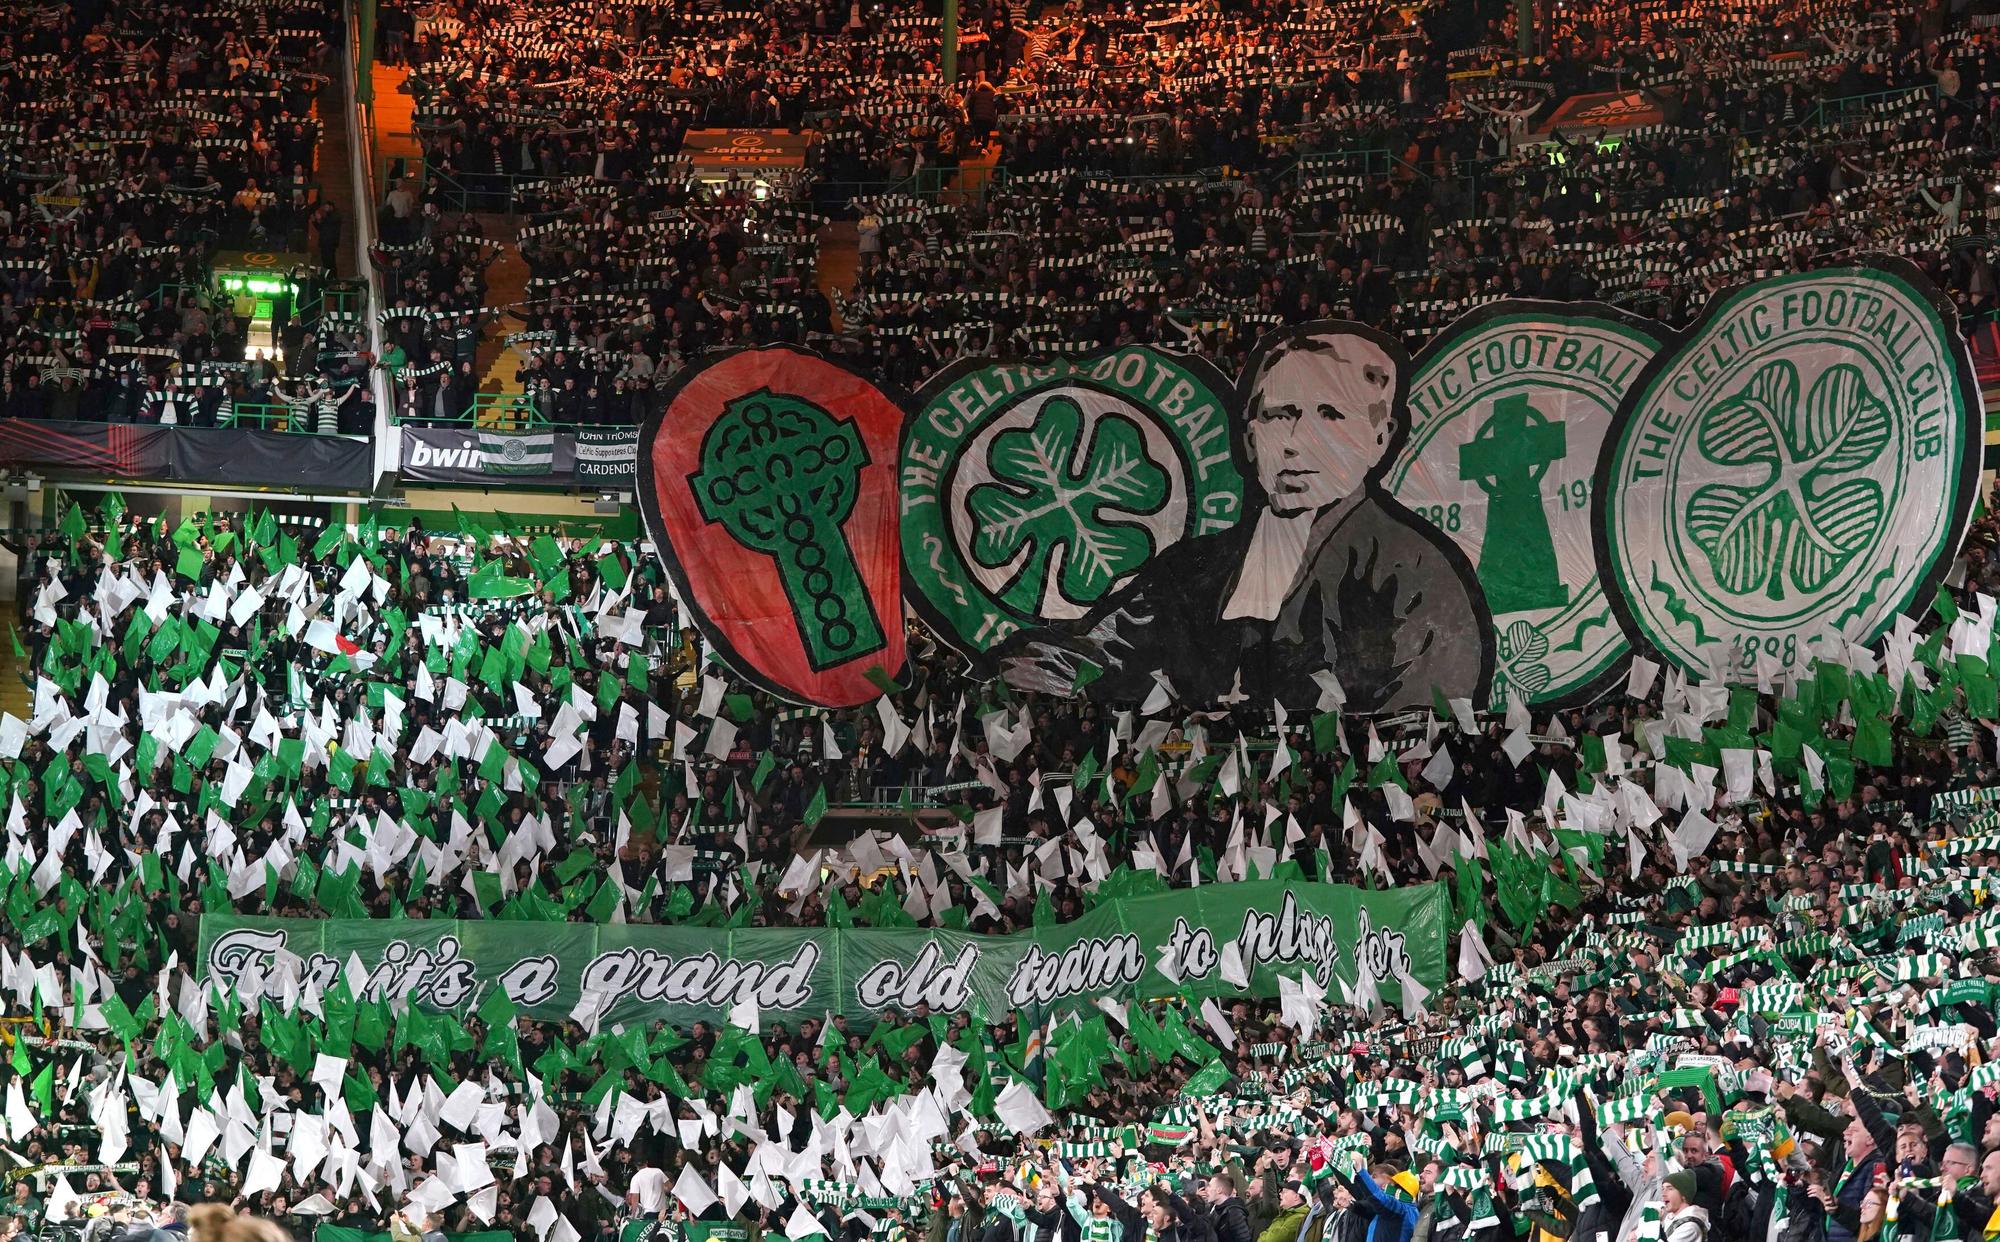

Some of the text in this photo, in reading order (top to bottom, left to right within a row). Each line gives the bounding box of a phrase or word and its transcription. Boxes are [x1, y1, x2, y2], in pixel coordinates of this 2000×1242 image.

[1577, 104, 1654, 118] adidas
[704, 146, 783, 155] dafabet
[1407, 334, 1638, 443] LTIC FOOTBALL
[1633, 289, 1942, 483] THE CELTIC FOOTBALL CLUB
[579, 431, 603, 440] JOHN
[579, 446, 594, 456] Celtic
[902, 438, 947, 515] THE
[1557, 474, 1594, 512] 19
[363, 935, 477, 1009] it's
[498, 954, 561, 1007] a
[580, 940, 820, 1019] grand
[856, 940, 980, 1014] old
[1004, 932, 1146, 1008] team
[1160, 915, 1220, 982] to
[1235, 889, 1340, 992] play
[1353, 905, 1411, 1000] for
